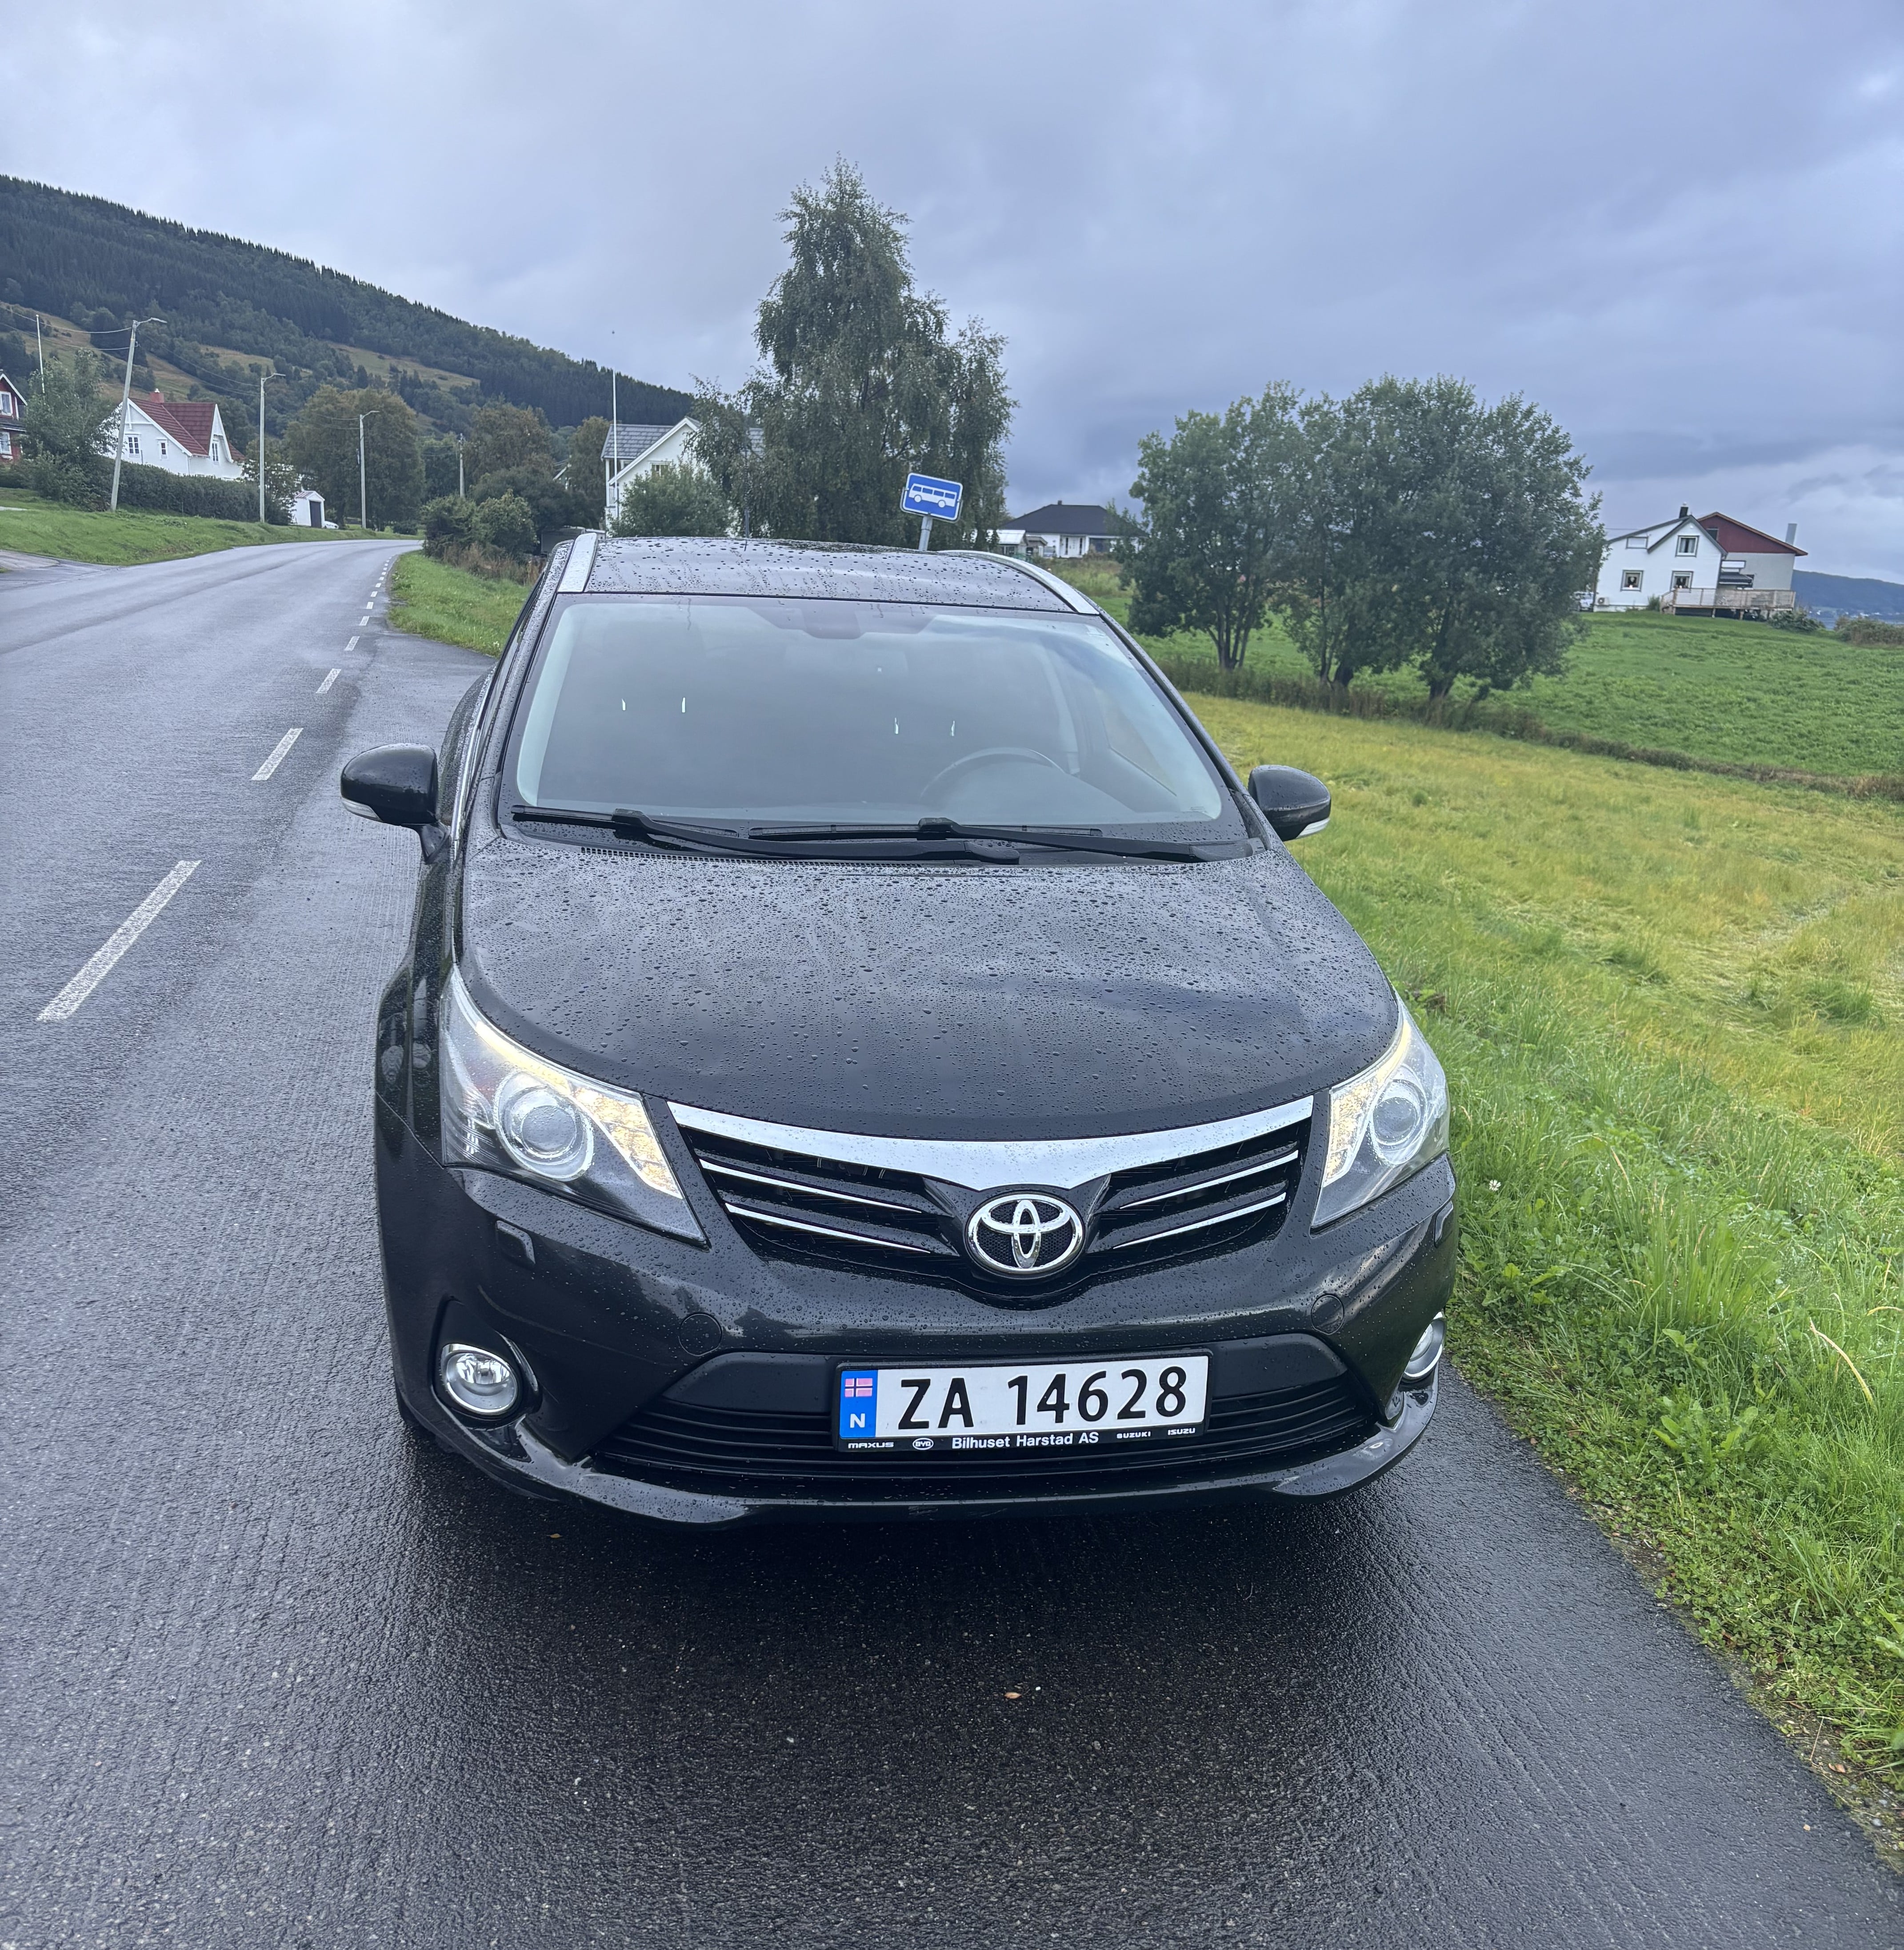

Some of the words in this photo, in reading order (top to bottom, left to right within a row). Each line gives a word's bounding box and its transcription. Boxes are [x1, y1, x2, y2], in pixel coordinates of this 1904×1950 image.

[898, 1377, 974, 1430] ZA
[1008, 1366, 1187, 1425] 14628
[850, 1413, 866, 1428] N
[952, 1436, 1010, 1449] Bilhuset
[1016, 1433, 1073, 1447] Harstad
[1079, 1431, 1099, 1444] AS
